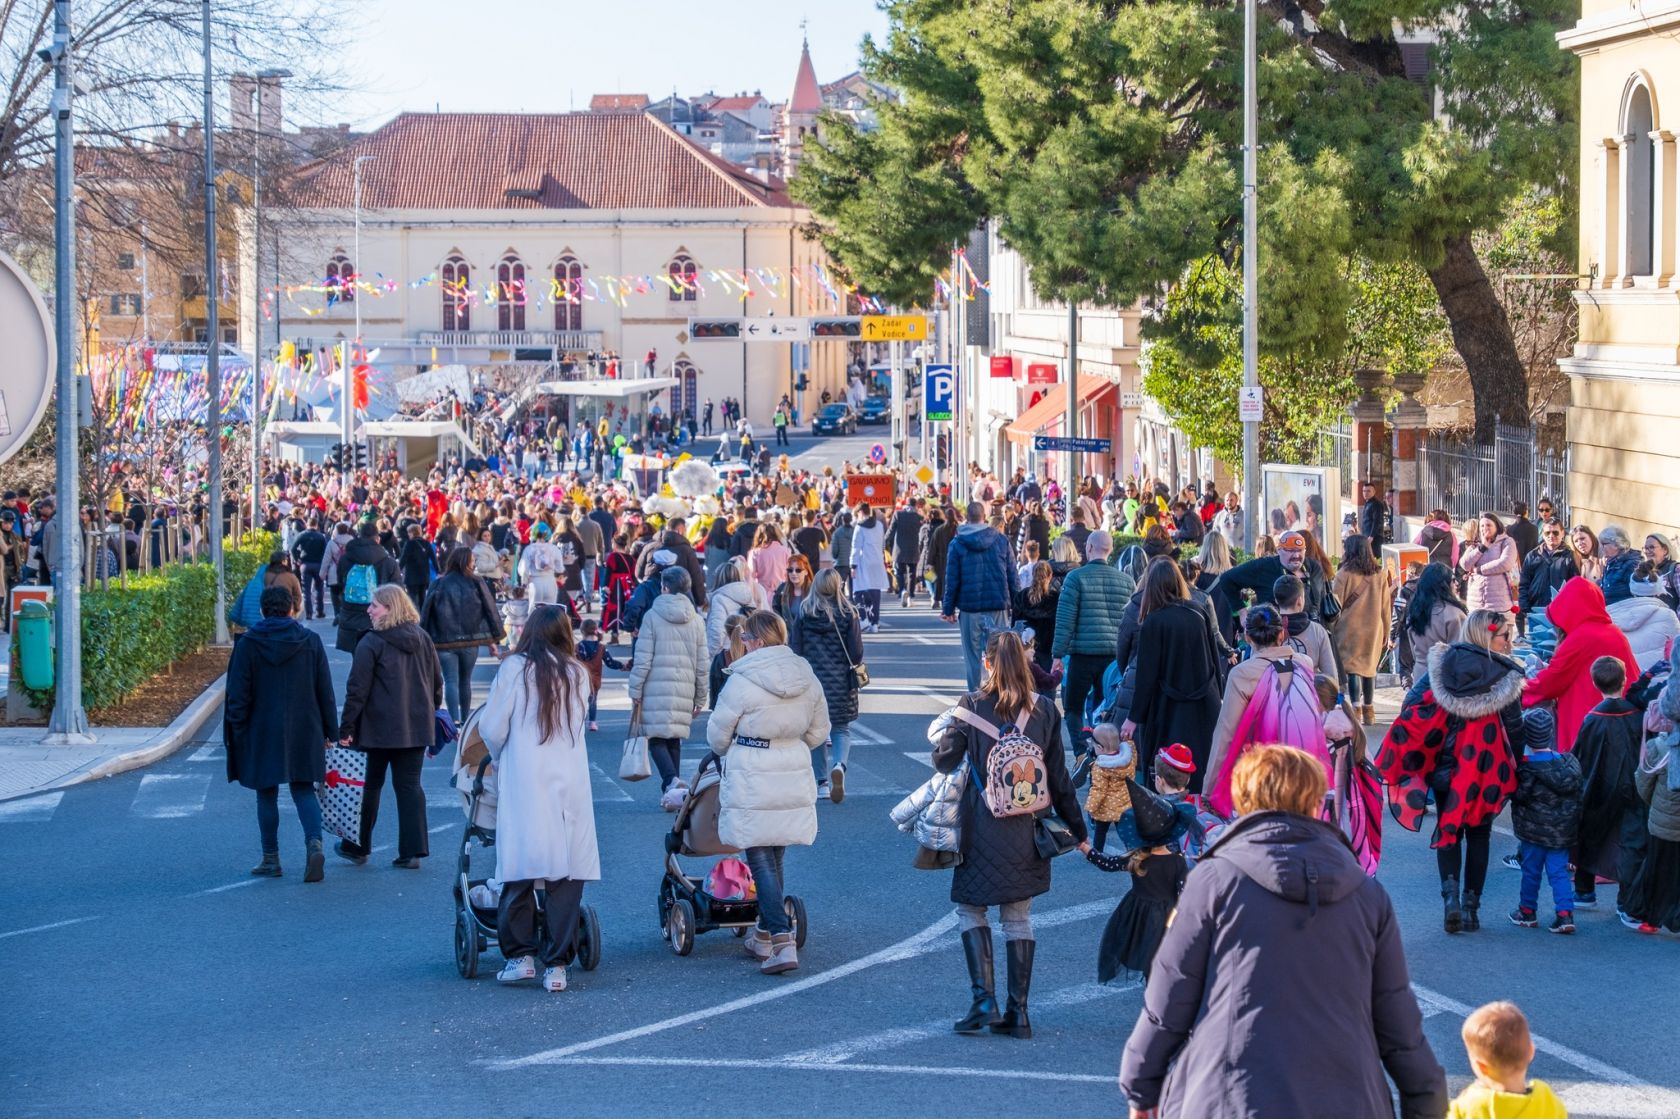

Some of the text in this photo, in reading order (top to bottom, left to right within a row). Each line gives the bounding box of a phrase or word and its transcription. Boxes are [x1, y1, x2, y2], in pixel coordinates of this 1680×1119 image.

[882, 319, 901, 327] Zadar
[882, 330, 906, 338] Vodice
[935, 376, 952, 402] P
[1303, 478, 1316, 487] EVN
[746, 738, 769, 748] Jeans
